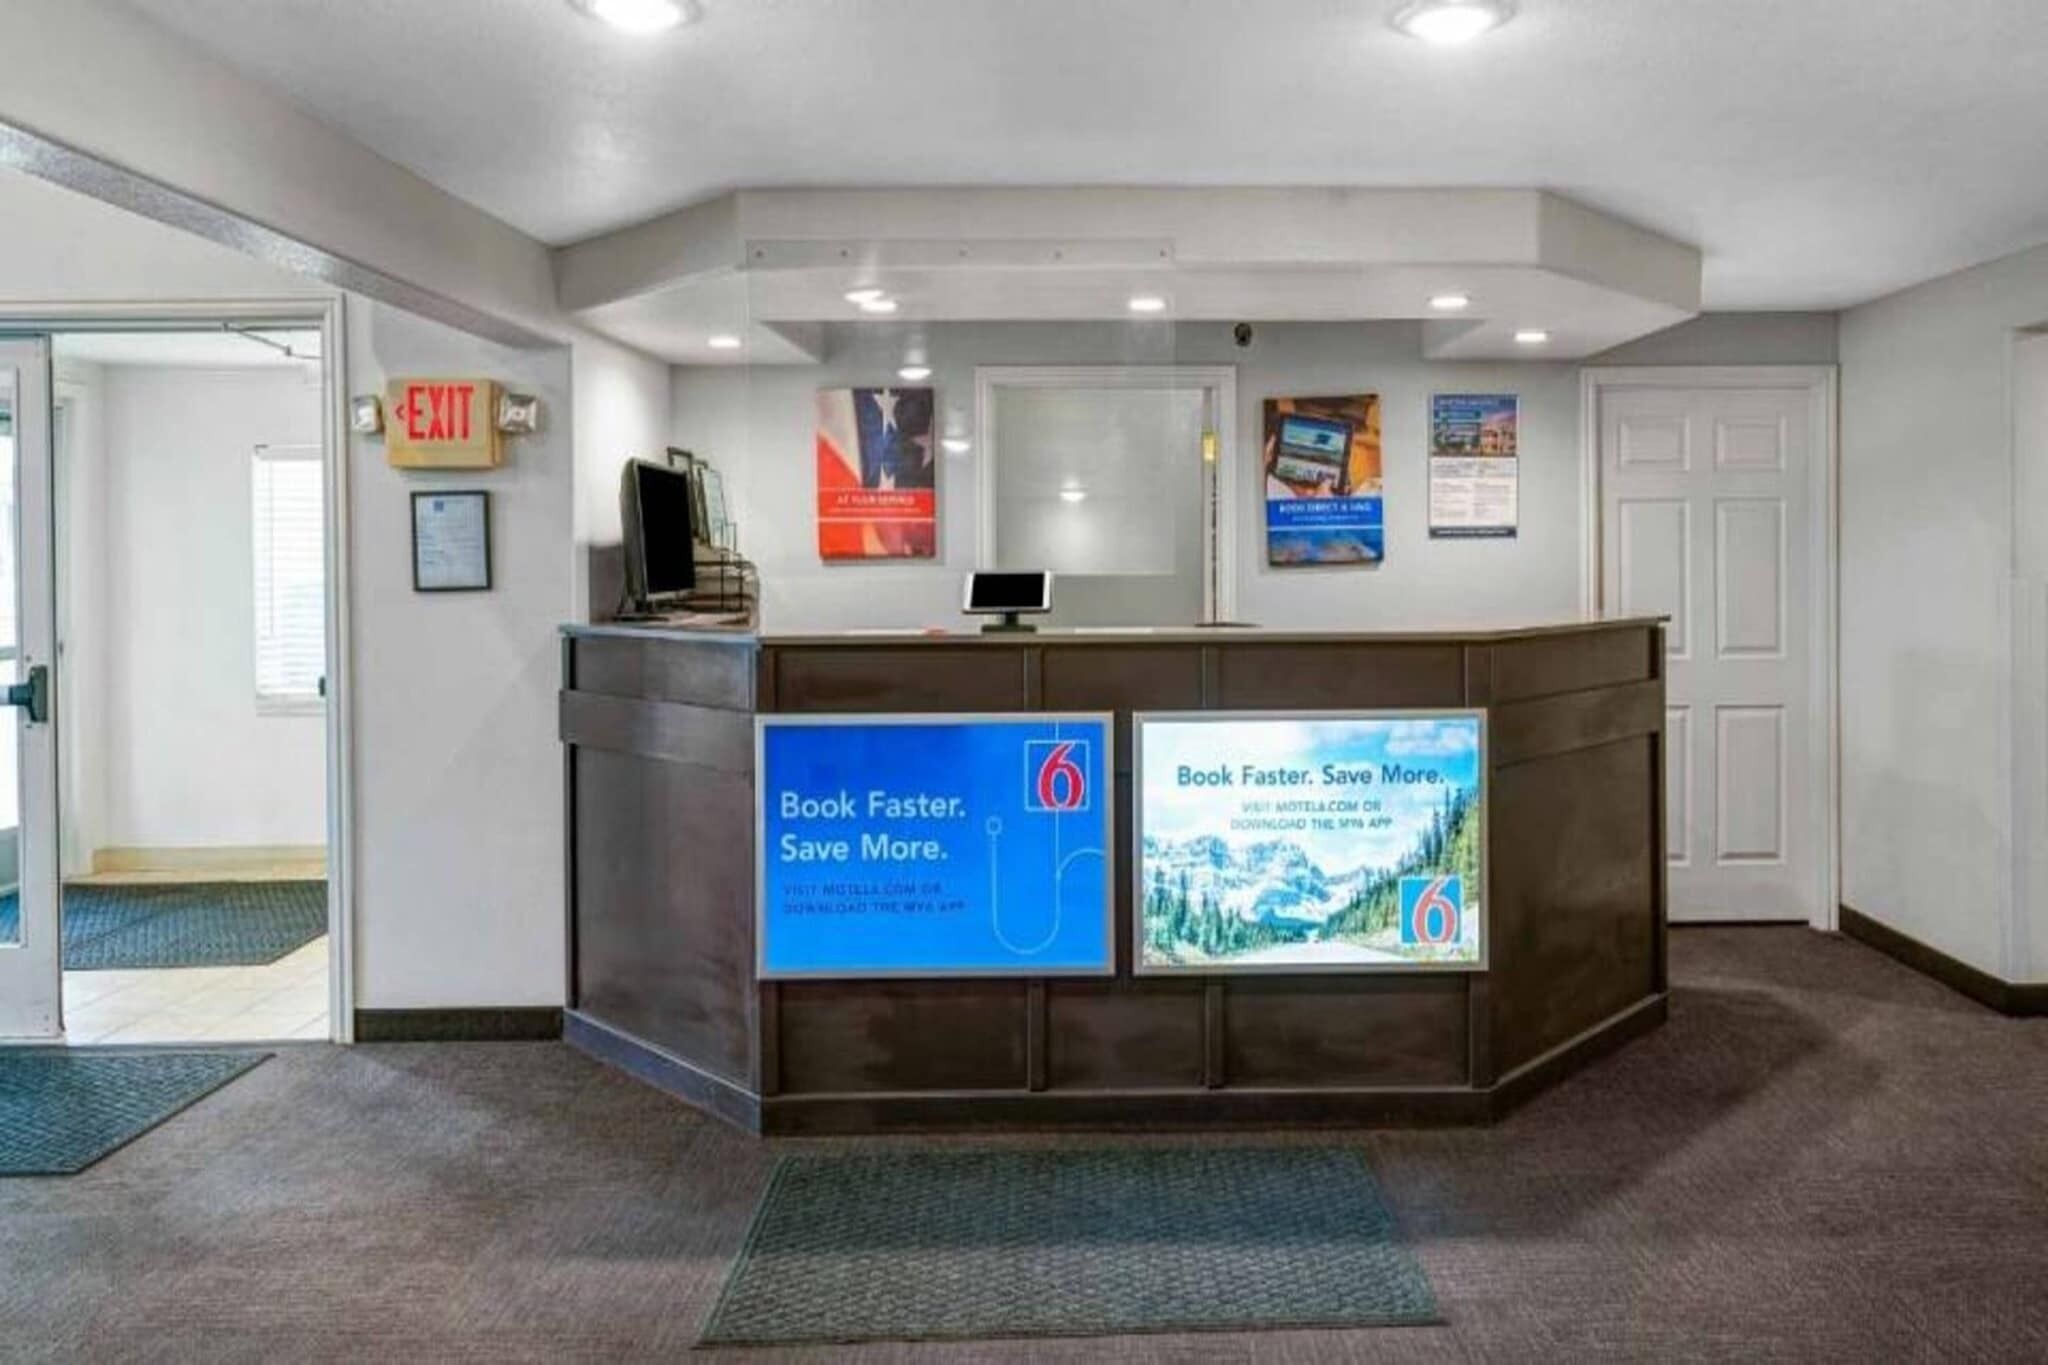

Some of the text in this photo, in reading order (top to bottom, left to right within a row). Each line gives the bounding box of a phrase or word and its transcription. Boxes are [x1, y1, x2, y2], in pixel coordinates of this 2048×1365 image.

[407, 385, 474, 440] EXIT
[1038, 740, 1085, 811] 6
[1177, 764, 1445, 786] Book Faster. Save More.
[780, 790, 966, 819] Book Faster.
[1241, 801, 1270, 813] VISIT
[1229, 818, 1306, 830] DOWNLOAD
[1311, 818, 1335, 830] THE
[1368, 817, 1393, 829] APP
[780, 833, 949, 862] Save More.
[784, 882, 817, 896] VISIT
[784, 902, 867, 915] DOWNLOAD
[873, 901, 899, 914] THE
[939, 900, 965, 912] APP
[1412, 874, 1458, 945] 6
